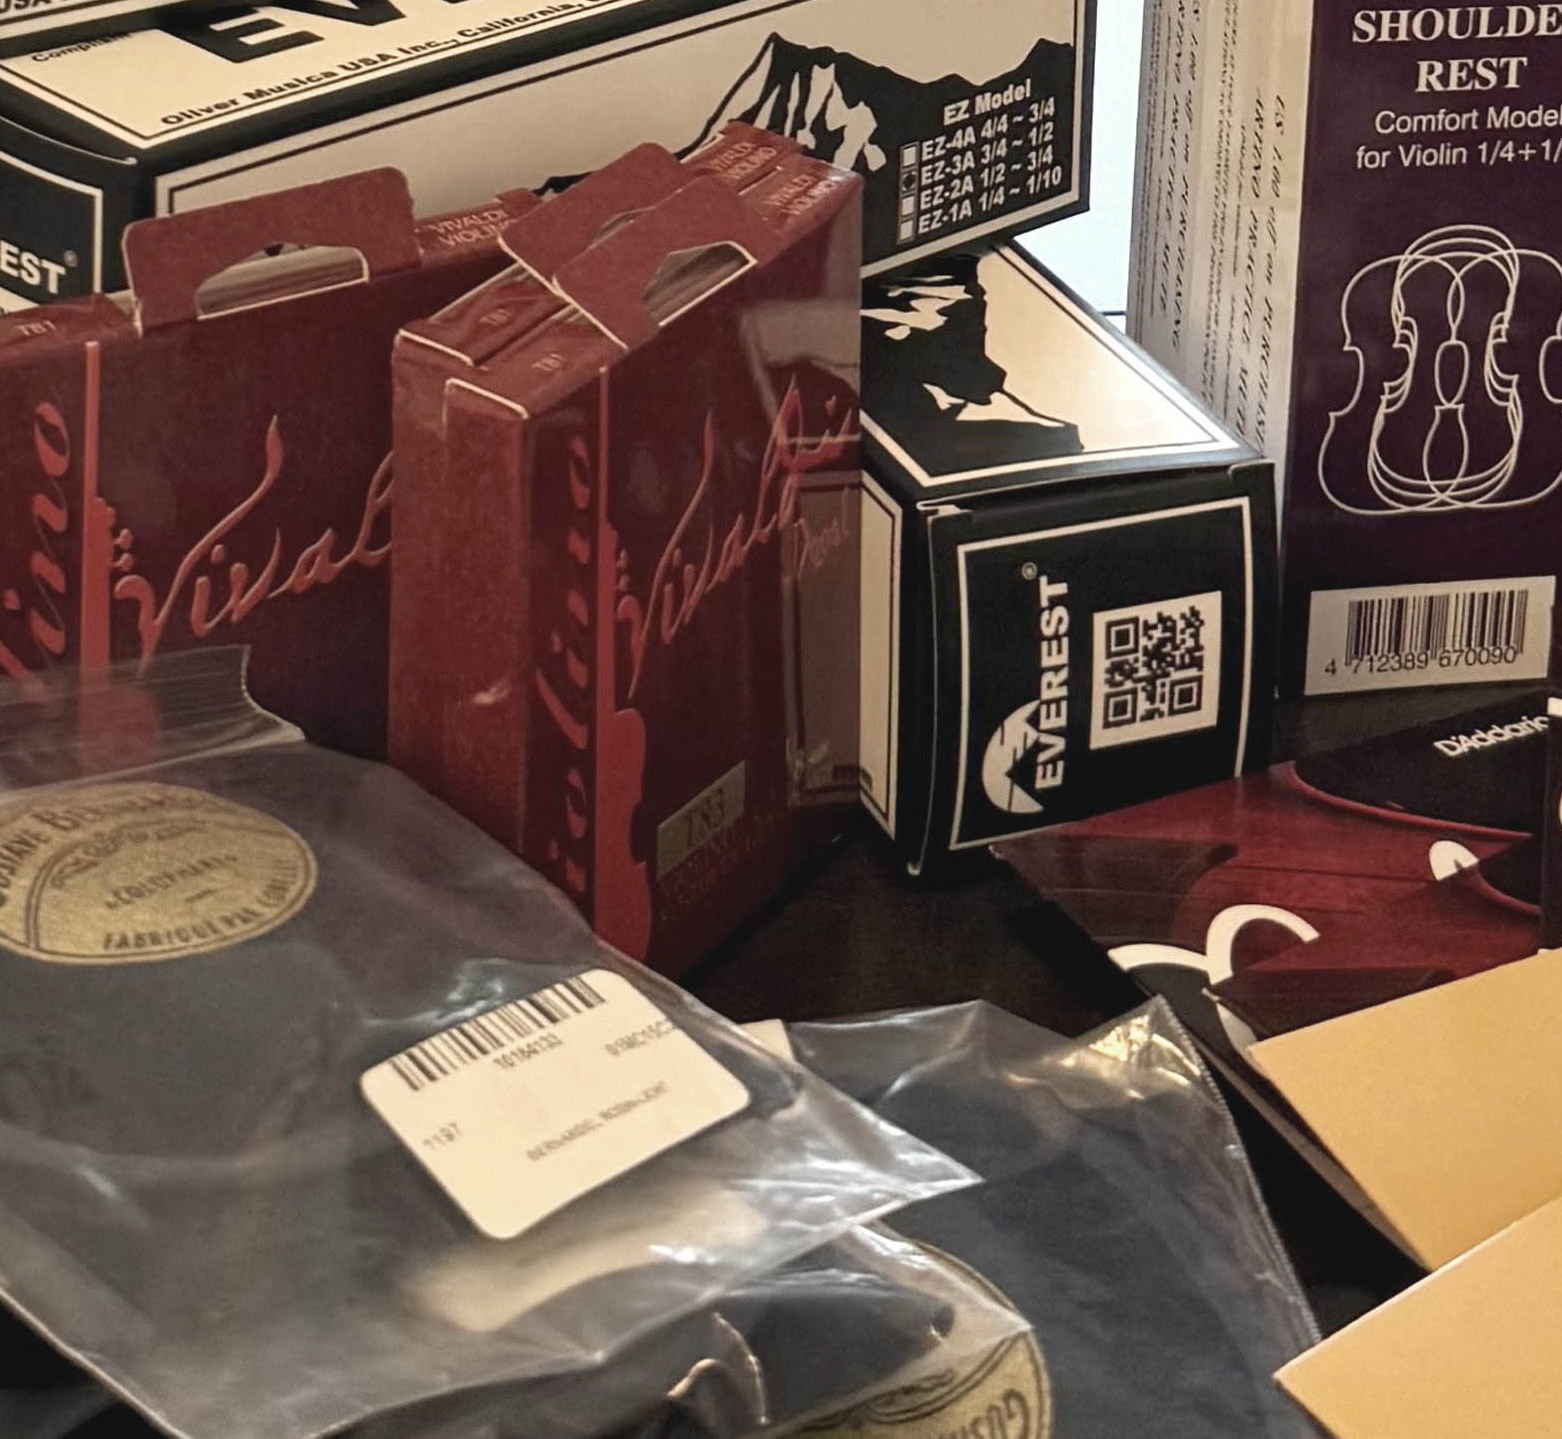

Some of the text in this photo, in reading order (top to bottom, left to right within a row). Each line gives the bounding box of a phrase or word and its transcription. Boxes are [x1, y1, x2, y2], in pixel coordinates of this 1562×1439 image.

[160, 98, 240, 126] Oliver
[244, 68, 336, 104] Musica
[336, 51, 398, 73] USA
[943, 77, 1032, 126] EZ Model
[1414, 54, 1528, 94] REST
[920, 95, 1056, 163] EZ-4A 4/4 3/4
[1374, 105, 1479, 136] Comfort
[919, 146, 1054, 210] EZ-2A 1/2 3/4
[920, 120, 1055, 186] EZ-3A 3/4 1/2
[1356, 144, 1389, 170] for
[1395, 141, 1469, 168] Violin
[917, 166, 1063, 236] EZ-1A 1/4 1/10
[1035, 575, 1072, 790] EVEREST
[1324, 644, 1518, 678] 4 712389 670090
